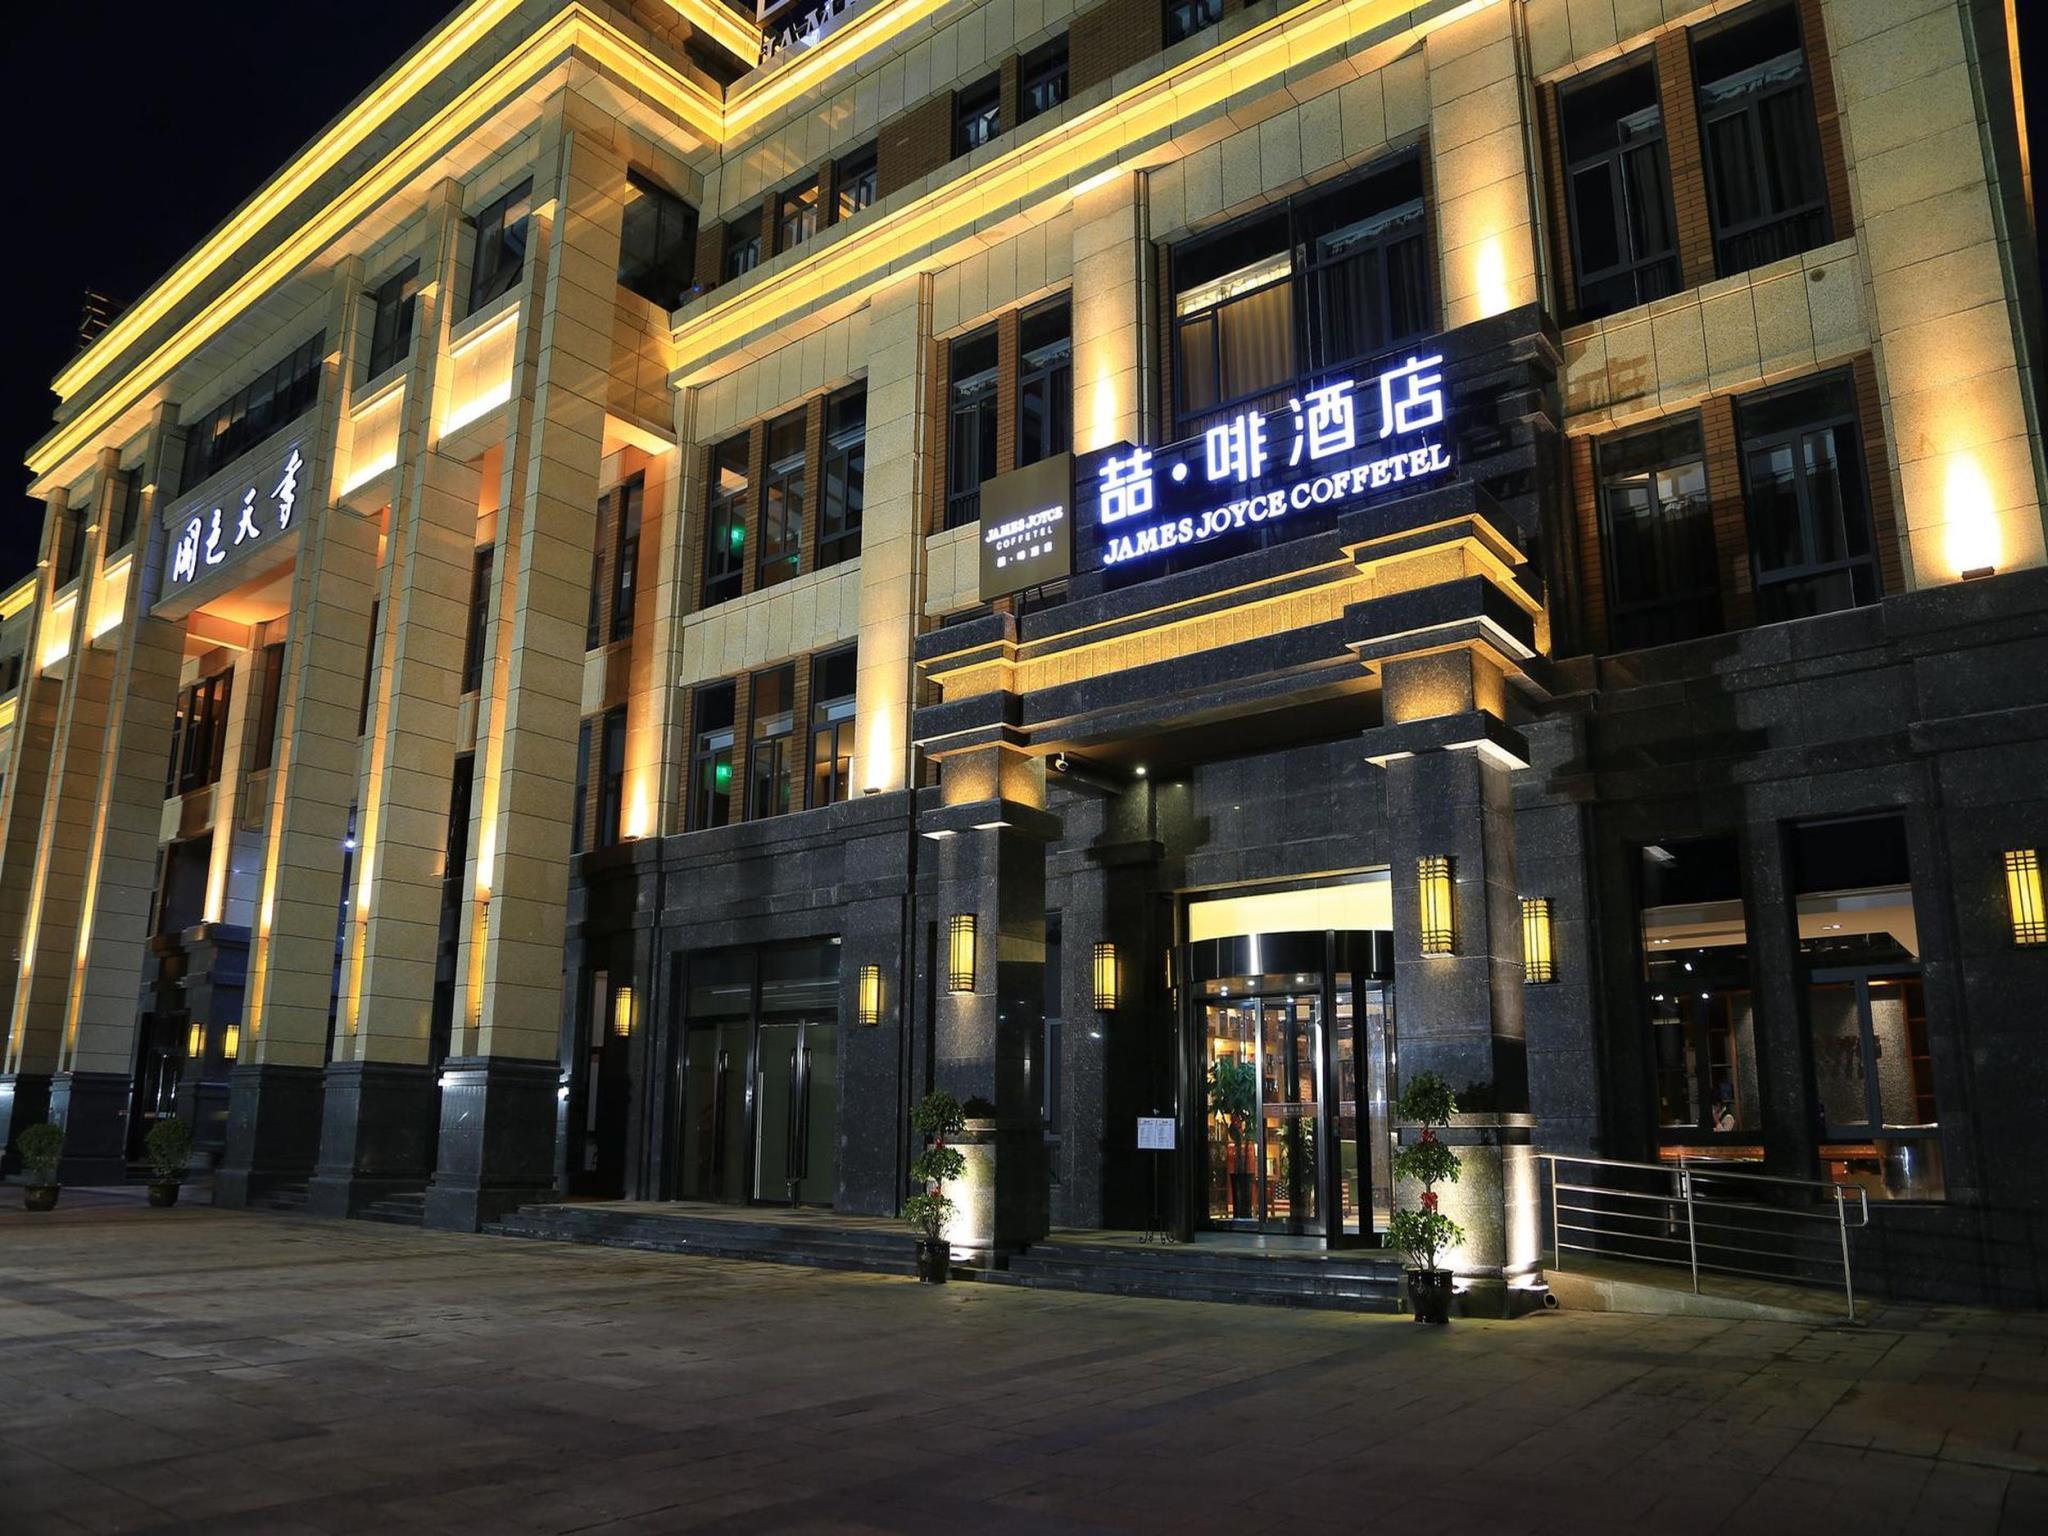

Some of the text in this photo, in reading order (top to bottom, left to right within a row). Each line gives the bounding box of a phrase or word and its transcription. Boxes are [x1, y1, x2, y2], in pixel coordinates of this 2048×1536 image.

[996, 525, 1053, 551] COFFETEL
[1103, 517, 1194, 565] JAMES
[1195, 489, 1288, 539] JOYCE
[1290, 443, 1451, 510] COFFETEL
